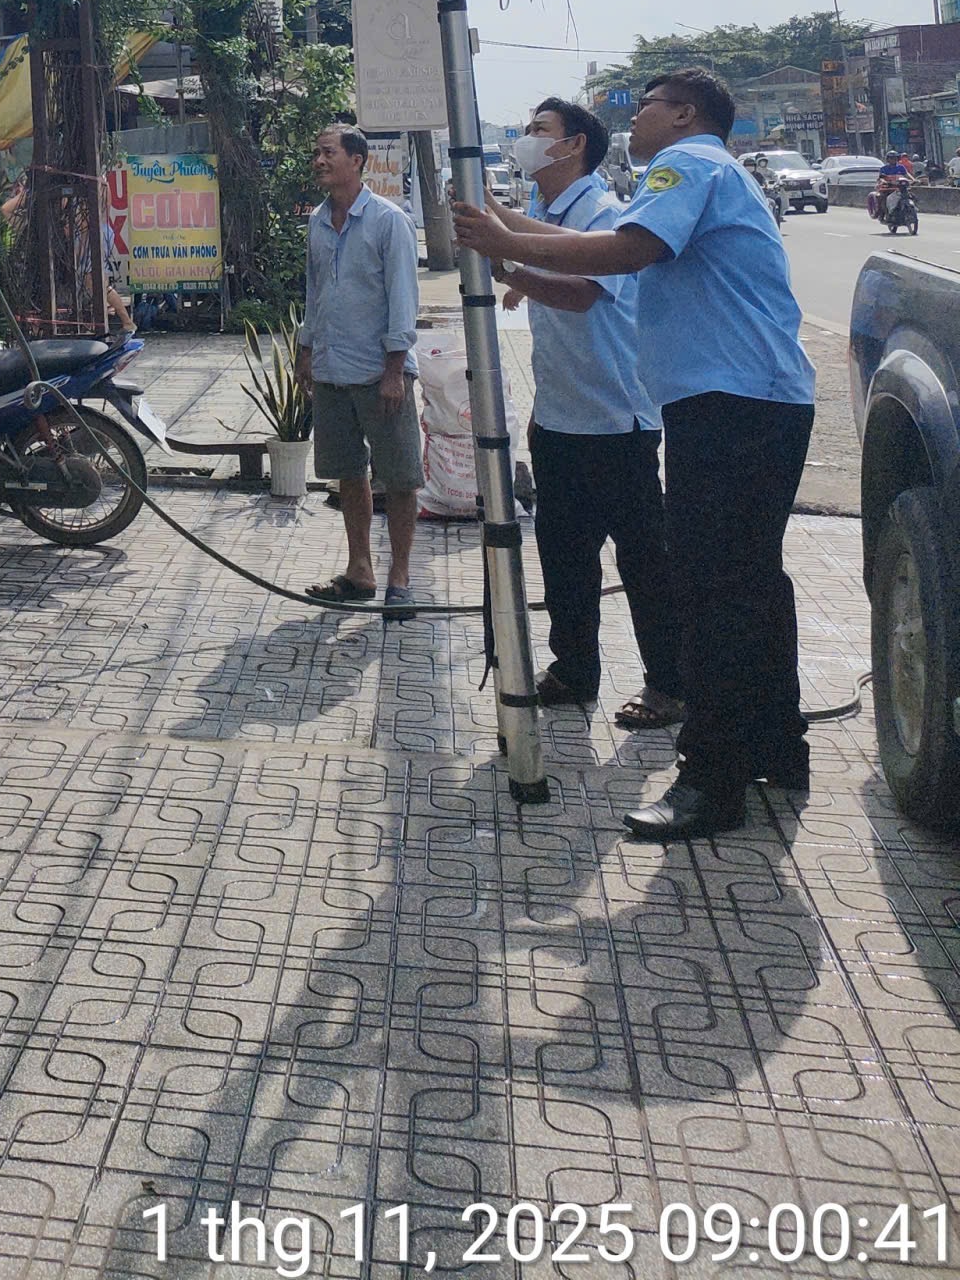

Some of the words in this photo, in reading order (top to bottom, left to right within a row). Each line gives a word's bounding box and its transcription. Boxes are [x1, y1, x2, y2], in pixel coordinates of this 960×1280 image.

[132, 188, 216, 229] CƠM
[133, 245, 149, 259] CƠM
[151, 245, 170, 259] TRƯA
[172, 243, 187, 258] VĂN
[190, 242, 217, 258] PHÒNG
